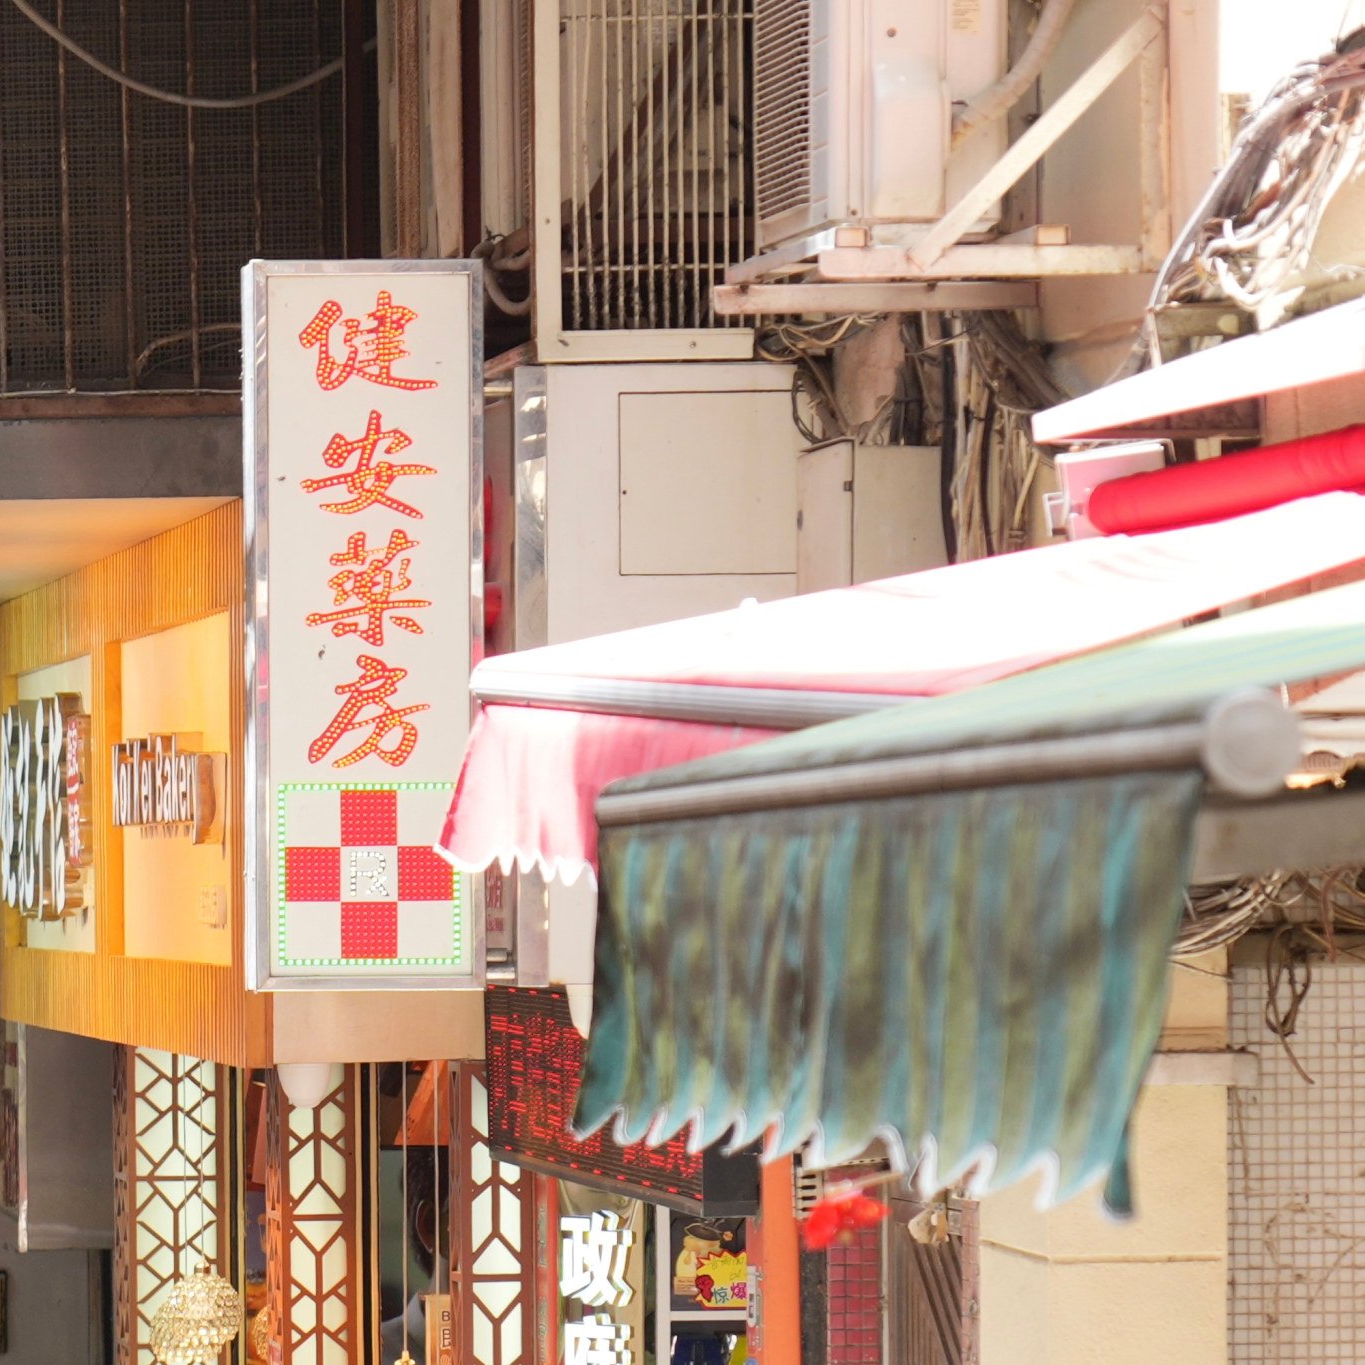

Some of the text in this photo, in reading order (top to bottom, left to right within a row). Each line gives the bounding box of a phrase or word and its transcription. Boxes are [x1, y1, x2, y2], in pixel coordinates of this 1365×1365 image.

[112, 738, 131, 826] Koi
[133, 734, 153, 824] Kei
[155, 733, 198, 844] Bakery
